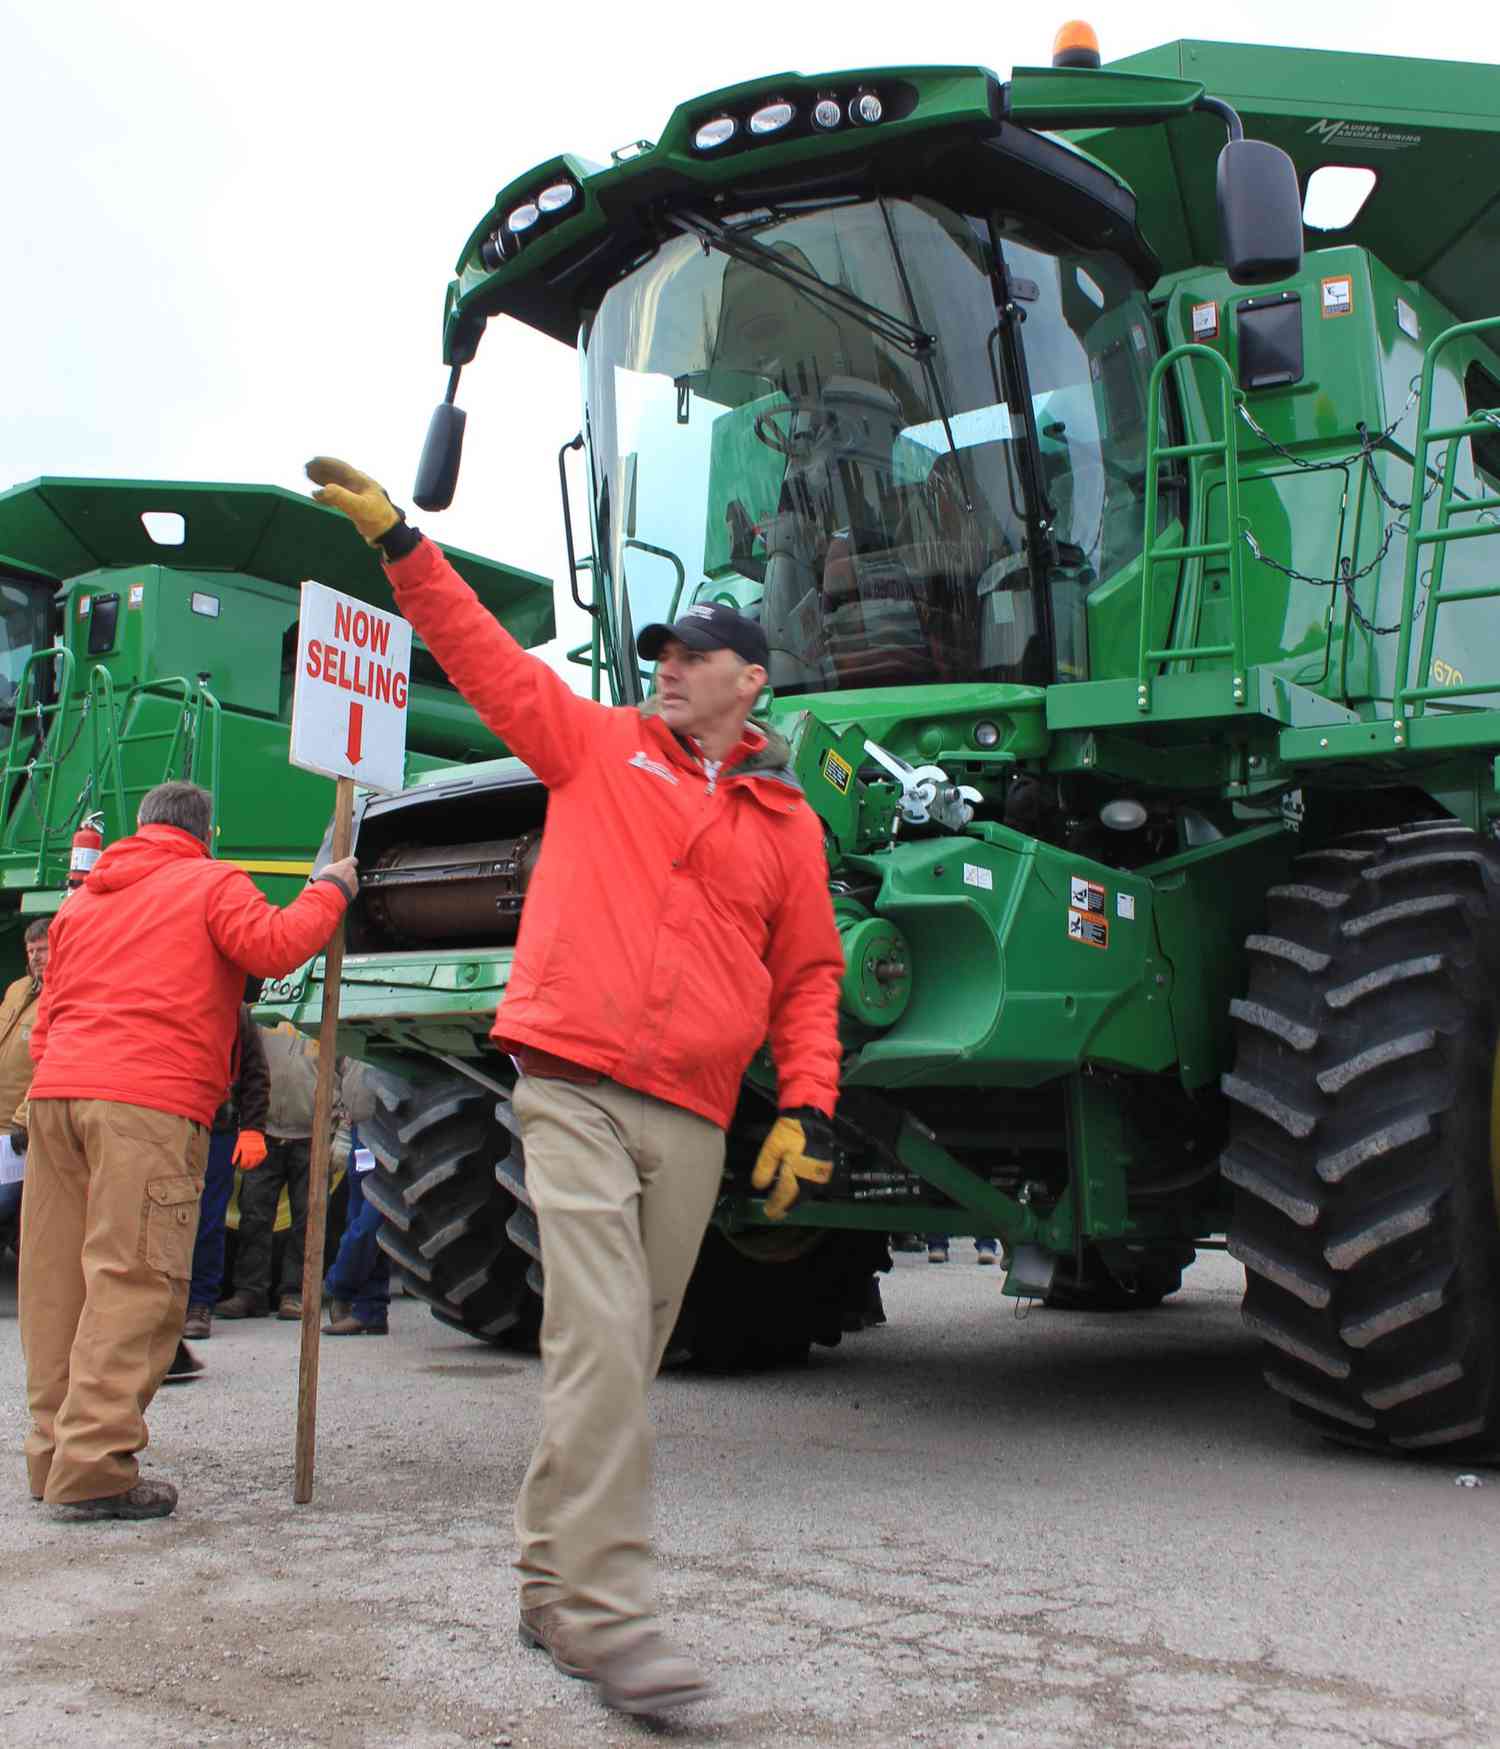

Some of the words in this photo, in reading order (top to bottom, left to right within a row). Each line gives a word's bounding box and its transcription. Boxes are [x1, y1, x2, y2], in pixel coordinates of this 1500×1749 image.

[334, 601, 391, 656] NOW
[306, 639, 408, 709] SELLING
[1433, 659, 1464, 688] 670
